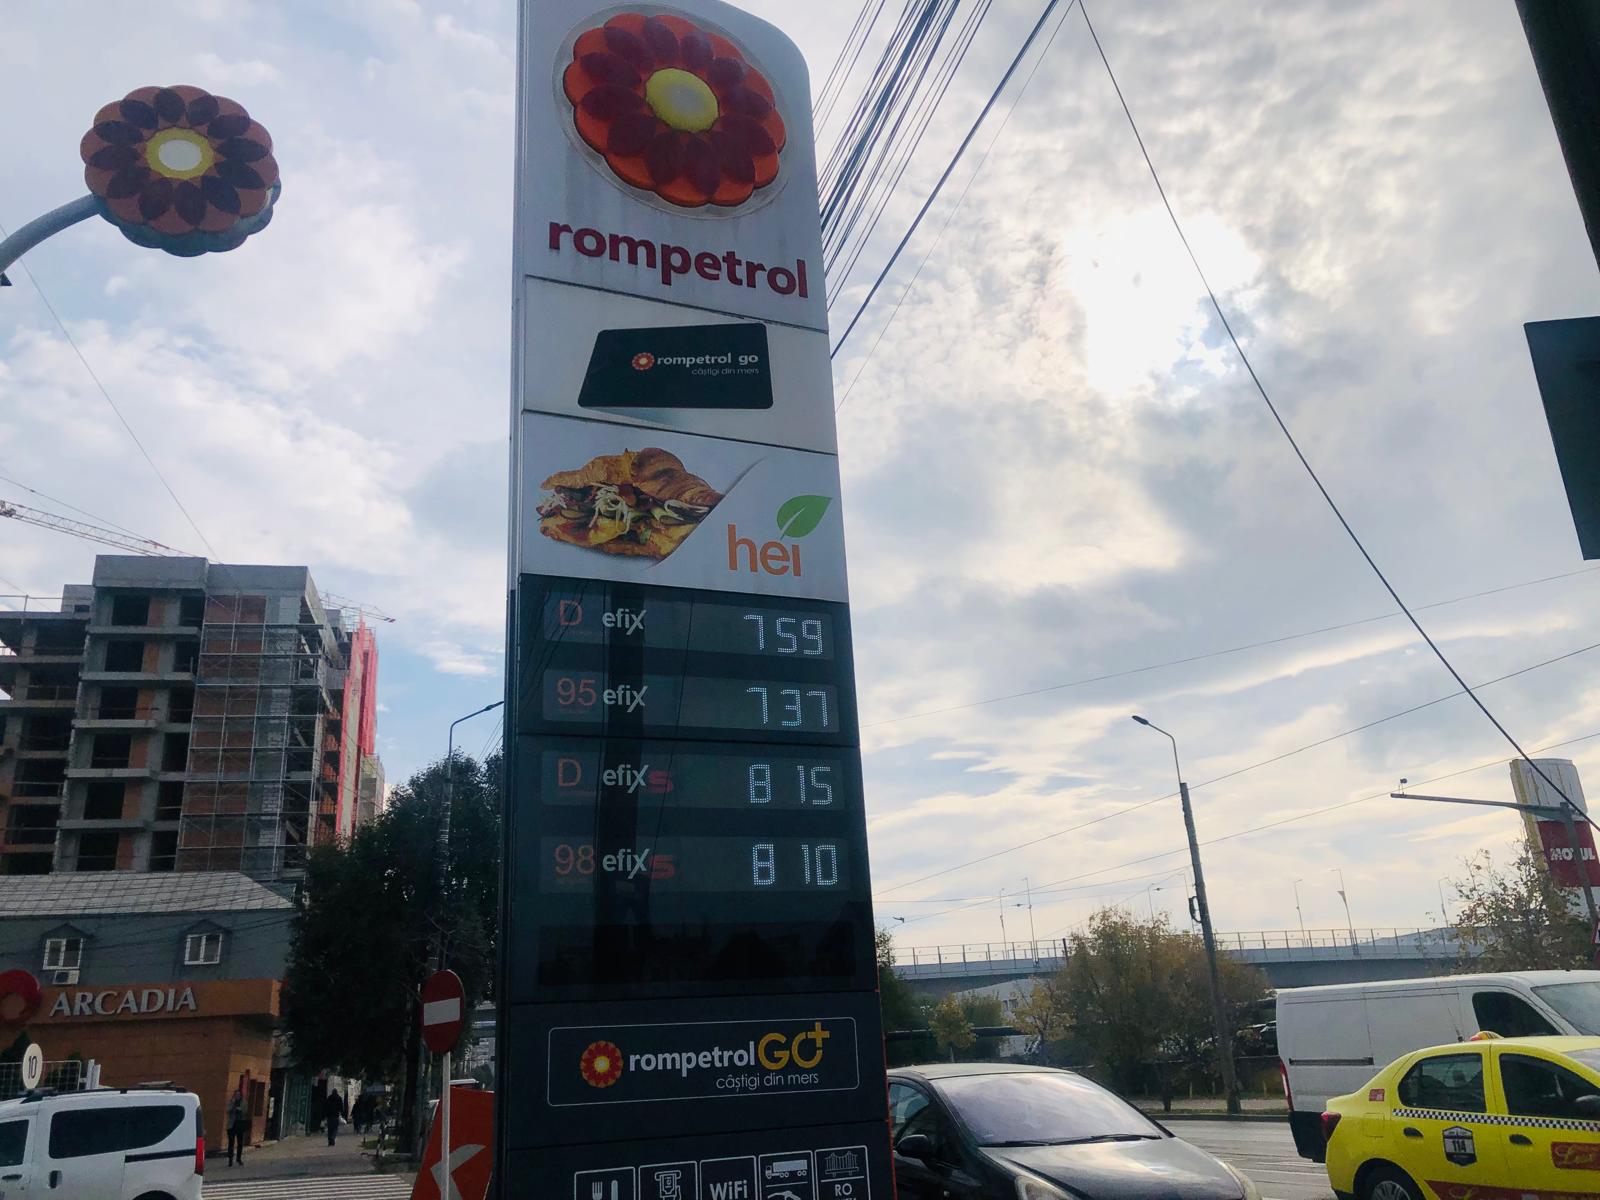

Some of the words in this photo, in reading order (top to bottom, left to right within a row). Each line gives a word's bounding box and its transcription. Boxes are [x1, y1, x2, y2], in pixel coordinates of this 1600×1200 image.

[549, 221, 808, 298] rompetrol
[657, 352, 732, 367] rompetrol
[739, 354, 759, 366] go
[721, 367, 736, 375] din
[727, 523, 802, 577] hei
[559, 600, 582, 625] D
[602, 608, 647, 635] efix
[557, 678, 596, 706] 95
[603, 685, 648, 713] efix
[558, 758, 582, 787] D
[555, 844, 595, 875] 98
[1550, 847, 1596, 861] MOUL
[50, 986, 198, 1017] ARCADIA
[28, 1055, 38, 1079] 10
[763, 1072, 784, 1087] din
[787, 1072, 819, 1086] mers
[709, 1179, 749, 1200] WiFi
[834, 1183, 853, 1196] RO
